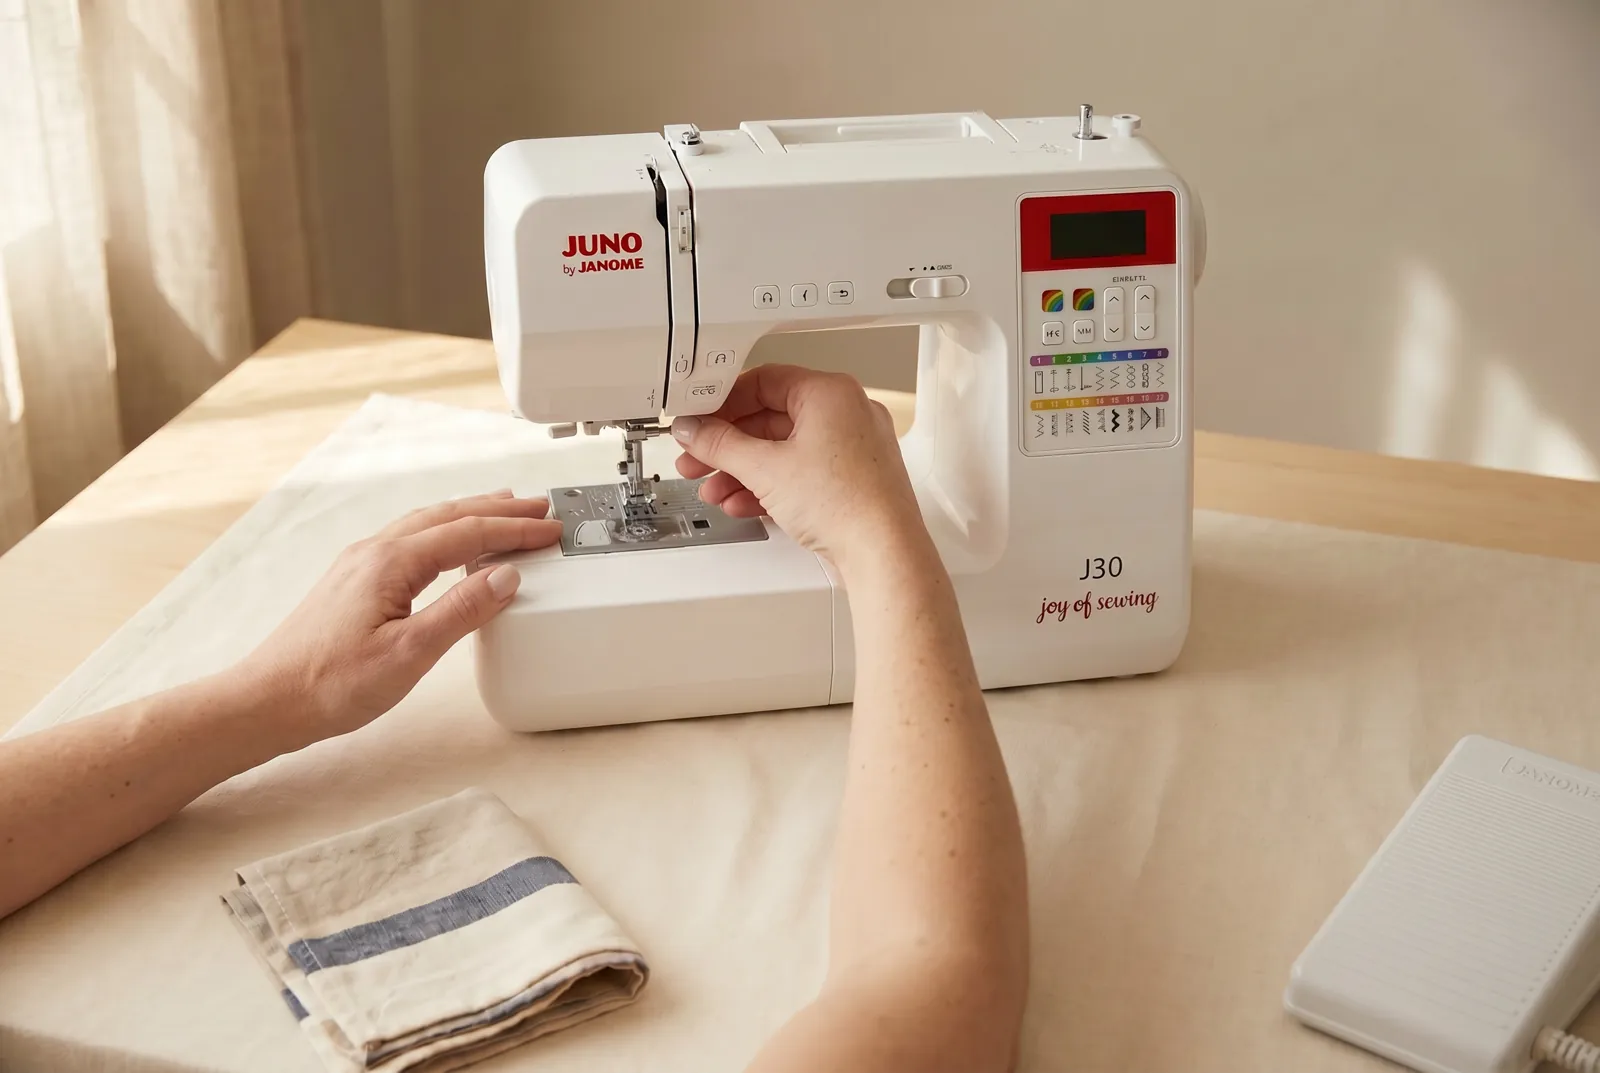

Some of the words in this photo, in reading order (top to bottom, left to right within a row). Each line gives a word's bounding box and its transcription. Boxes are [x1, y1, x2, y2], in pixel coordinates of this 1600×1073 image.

[561, 232, 643, 258] JUNO
[563, 263, 576, 277] by
[578, 257, 645, 273] JANOME
[1079, 556, 1123, 580] J30
[1036, 597, 1070, 624] joy
[1073, 590, 1092, 619] of
[1096, 590, 1159, 613] sewing
